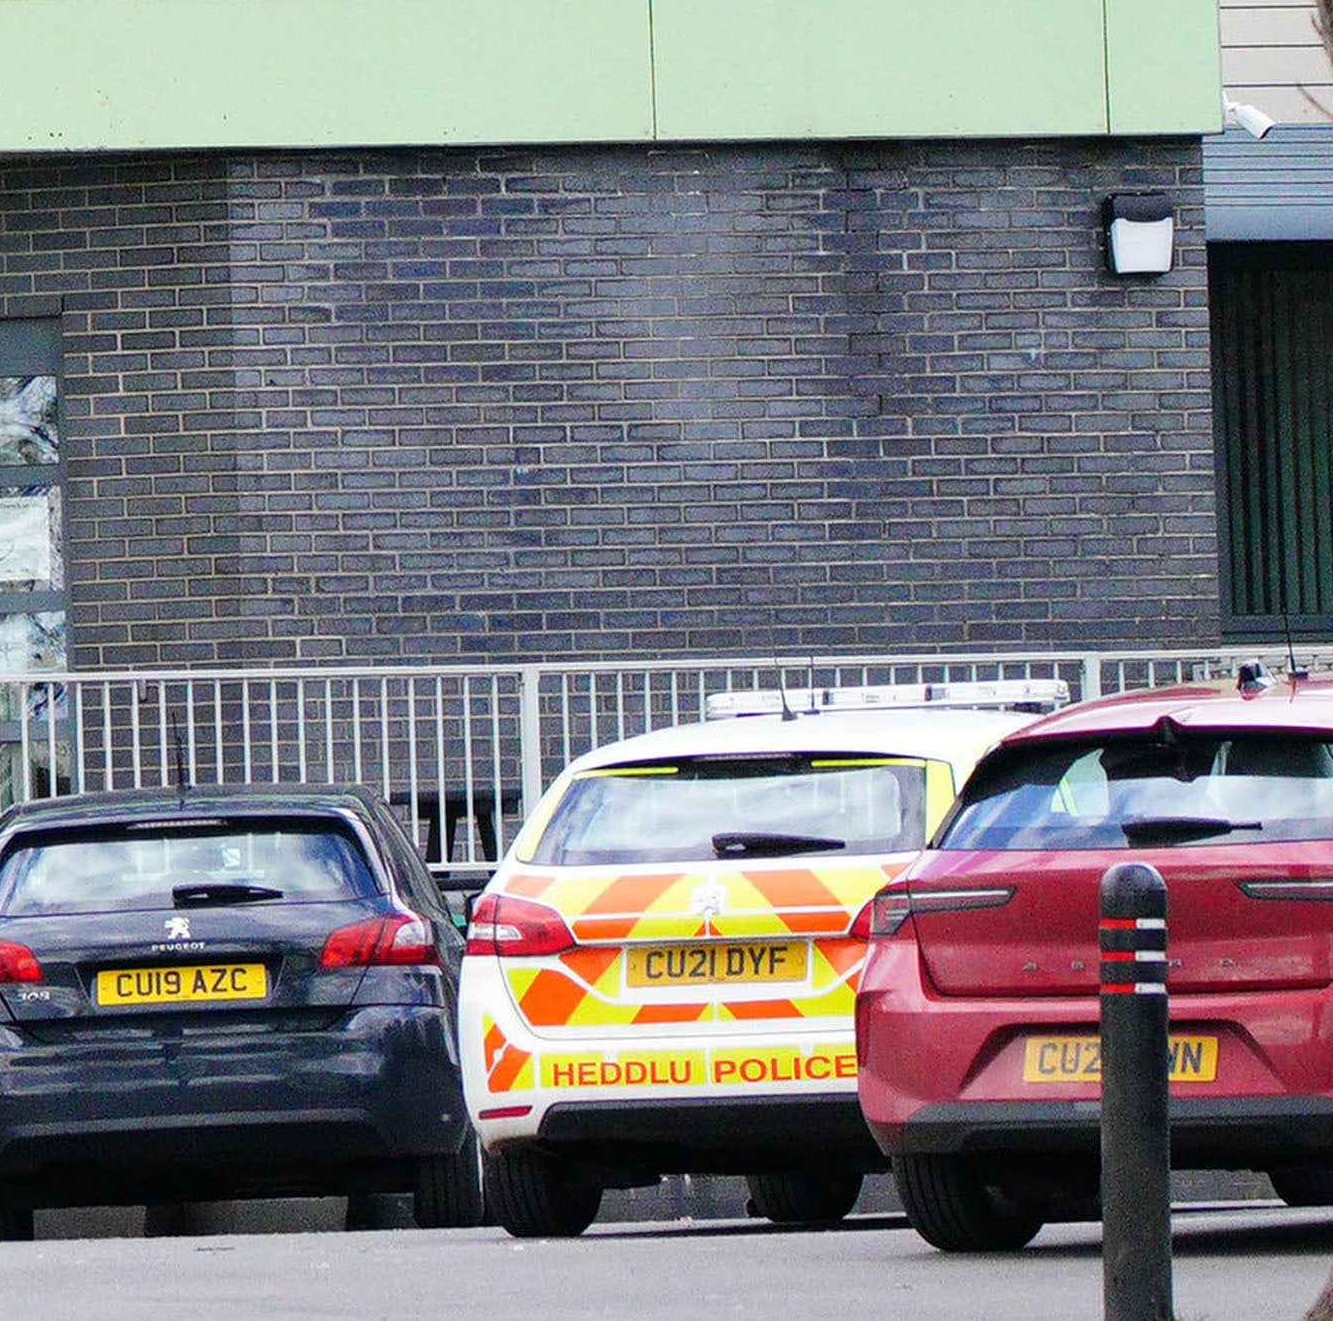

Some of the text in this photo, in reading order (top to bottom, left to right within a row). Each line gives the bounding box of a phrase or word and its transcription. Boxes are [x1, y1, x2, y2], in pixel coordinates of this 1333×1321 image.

[151, 941, 206, 952] PEUGEOT
[645, 946, 788, 979] CU21 DYF
[115, 967, 249, 998] CU19 AZC
[552, 1055, 858, 1087] HEDDLU POLICE
[1038, 1042, 1103, 1075] CU2
